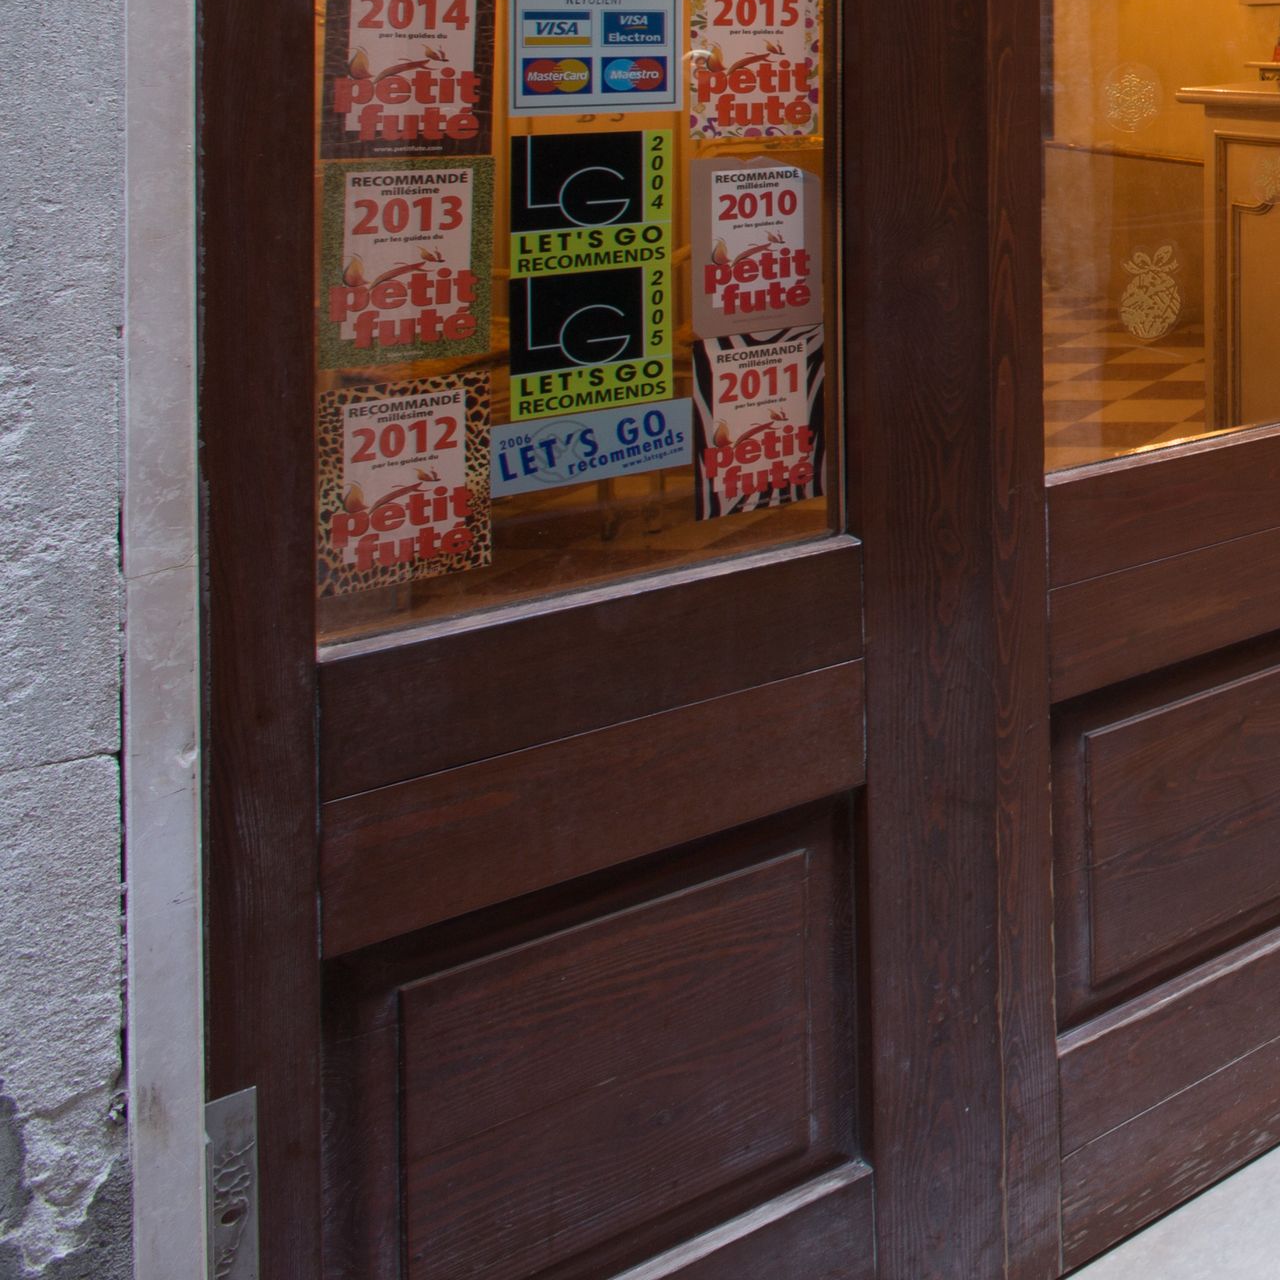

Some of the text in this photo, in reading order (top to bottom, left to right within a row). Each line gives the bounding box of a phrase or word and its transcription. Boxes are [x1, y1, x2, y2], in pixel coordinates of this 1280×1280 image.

[536, 21, 579, 36] VISA
[619, 15, 648, 26] VISA
[608, 33, 661, 43] Electron
[333, 67, 481, 113] petit
[528, 71, 588, 81] MasterCard
[610, 70, 660, 80] Maestro
[697, 59, 812, 103] petit
[358, 103, 480, 142] futé
[715, 93, 812, 127] futé
[351, 171, 469, 187] RECOMMANDÉ
[651, 135, 665, 210] 2004
[715, 168, 800, 184] RECOMMANDÉ
[736, 181, 780, 191] millésime
[381, 186, 440, 197] millésime
[718, 189, 797, 221] 2010
[352, 195, 463, 235] 2013
[373, 237, 390, 245] par
[403, 234, 431, 243] guides
[519, 225, 664, 255] LET'S GO
[517, 246, 666, 273] RECOMMENDS
[704, 247, 811, 294] petit
[328, 267, 478, 323] petit
[650, 270, 664, 346] 2005
[721, 278, 811, 316] futé
[353, 306, 478, 349] futé
[716, 343, 804, 364] RECOMMANDÉ
[738, 357, 783, 369] millésime
[520, 360, 664, 397] LET'S GO
[718, 363, 798, 404] 2011
[348, 393, 462, 418] RECOMMANDÉ
[518, 381, 667, 416] RECOMMENDS
[377, 409, 434, 424] millésime
[351, 416, 458, 464] 2012
[498, 434, 532, 451] 2006
[498, 410, 666, 482] LET'S GO
[568, 429, 684, 476] recommends
[622, 445, 684, 469] www.letsgo.com
[703, 424, 814, 479] petit
[371, 462, 387, 470] par
[400, 455, 427, 467] guides
[723, 455, 814, 500] futé
[331, 486, 473, 549] petit
[354, 521, 474, 571] futé
